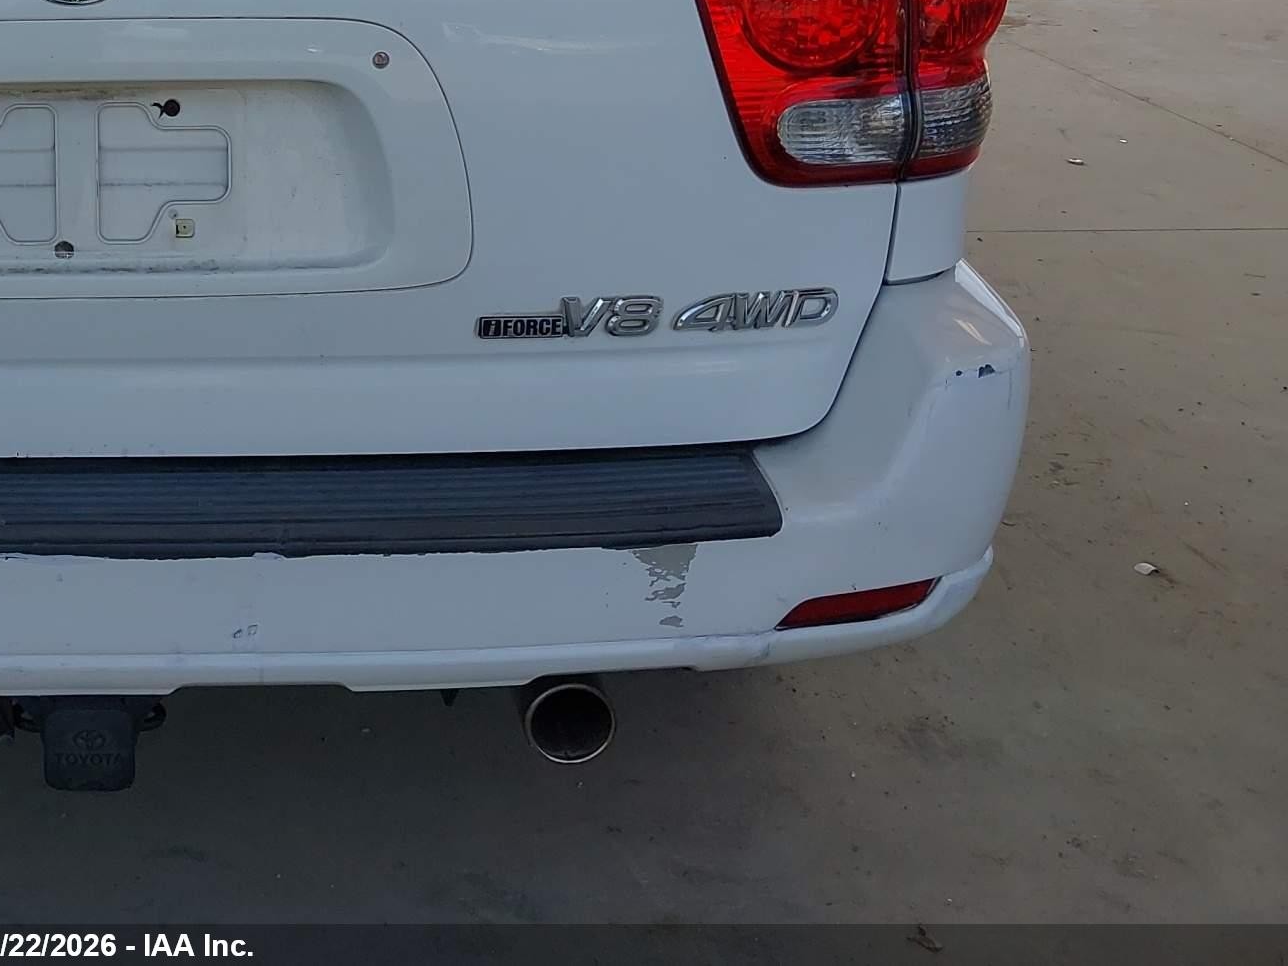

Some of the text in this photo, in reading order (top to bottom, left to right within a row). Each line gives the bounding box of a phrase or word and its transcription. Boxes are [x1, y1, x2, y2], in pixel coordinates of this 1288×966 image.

[559, 295, 664, 338] V8
[673, 287, 840, 332] 4WD
[53, 752, 124, 767] TOYOTA
